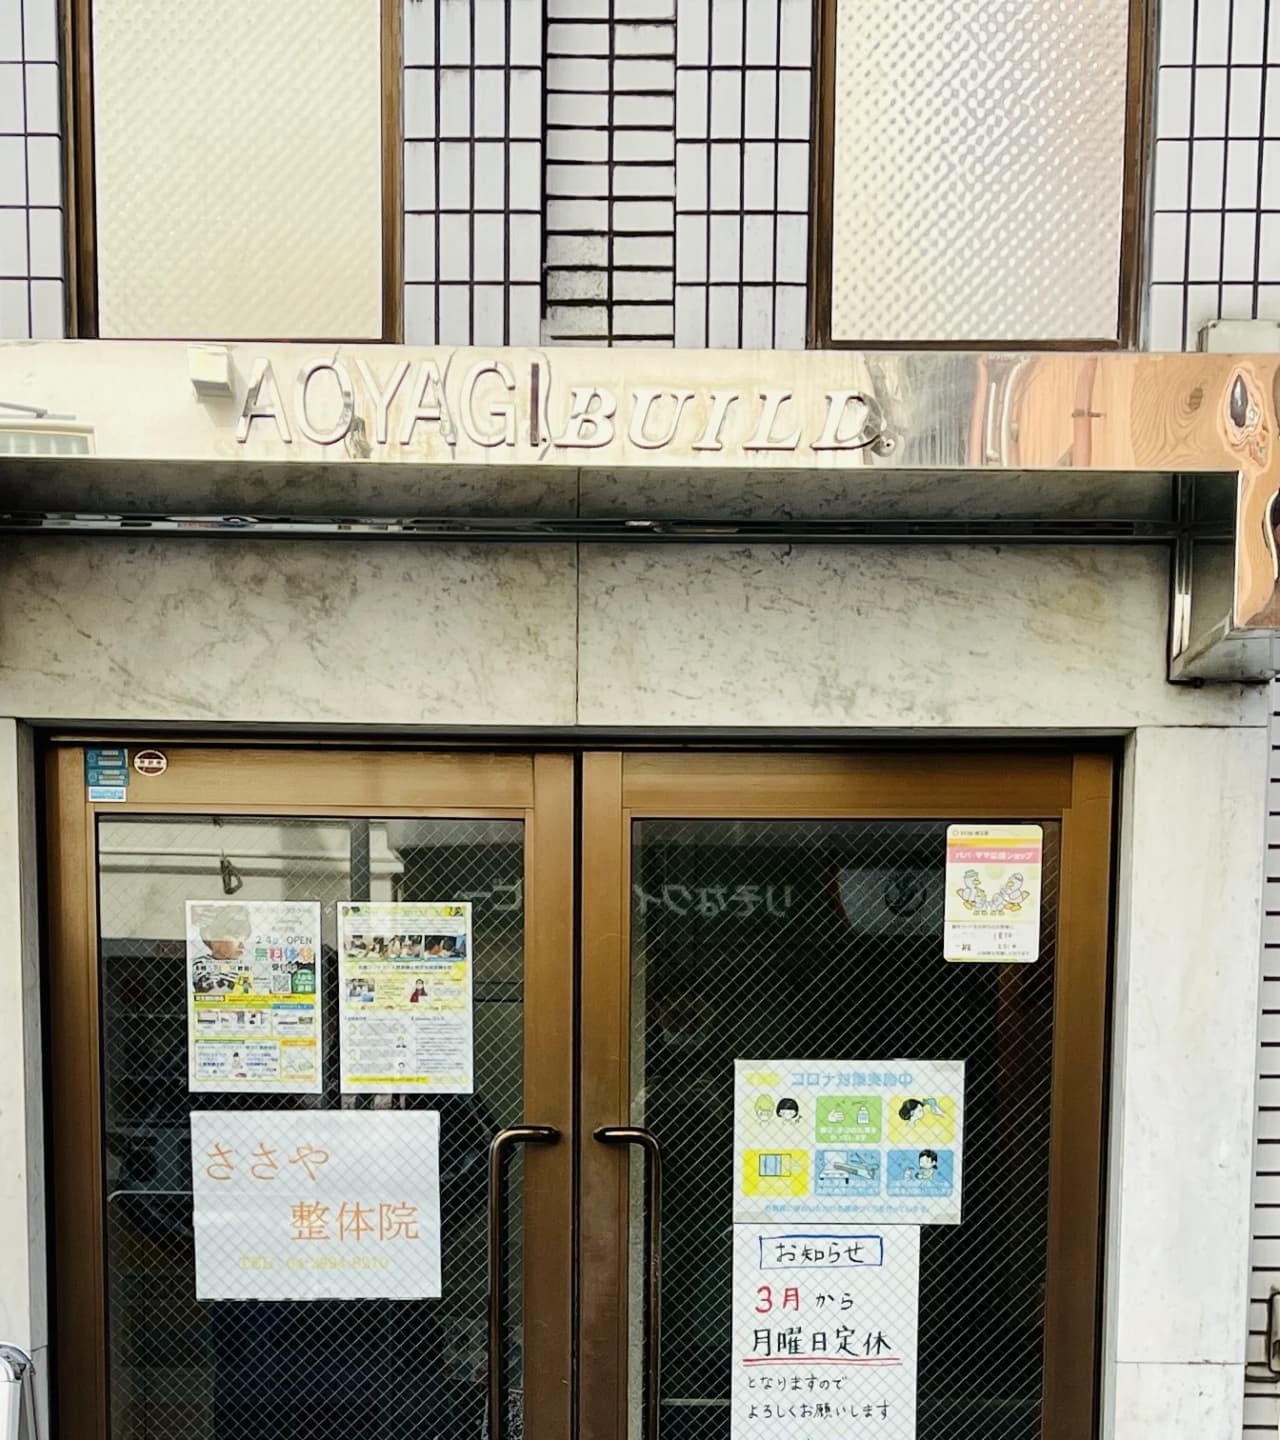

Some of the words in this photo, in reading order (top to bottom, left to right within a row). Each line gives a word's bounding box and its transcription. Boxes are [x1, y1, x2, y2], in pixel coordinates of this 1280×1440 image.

[236, 357, 541, 449] AOYAGI
[206, 1142, 330, 1182] ささや
[290, 1201, 421, 1241] 整体院
[775, 1241, 865, 1264] お知らせ
[752, 1326, 893, 1357] 月曜日定休
[747, 1373, 848, 1393] となりますので
[747, 1400, 891, 1420] よろしくお願いします
